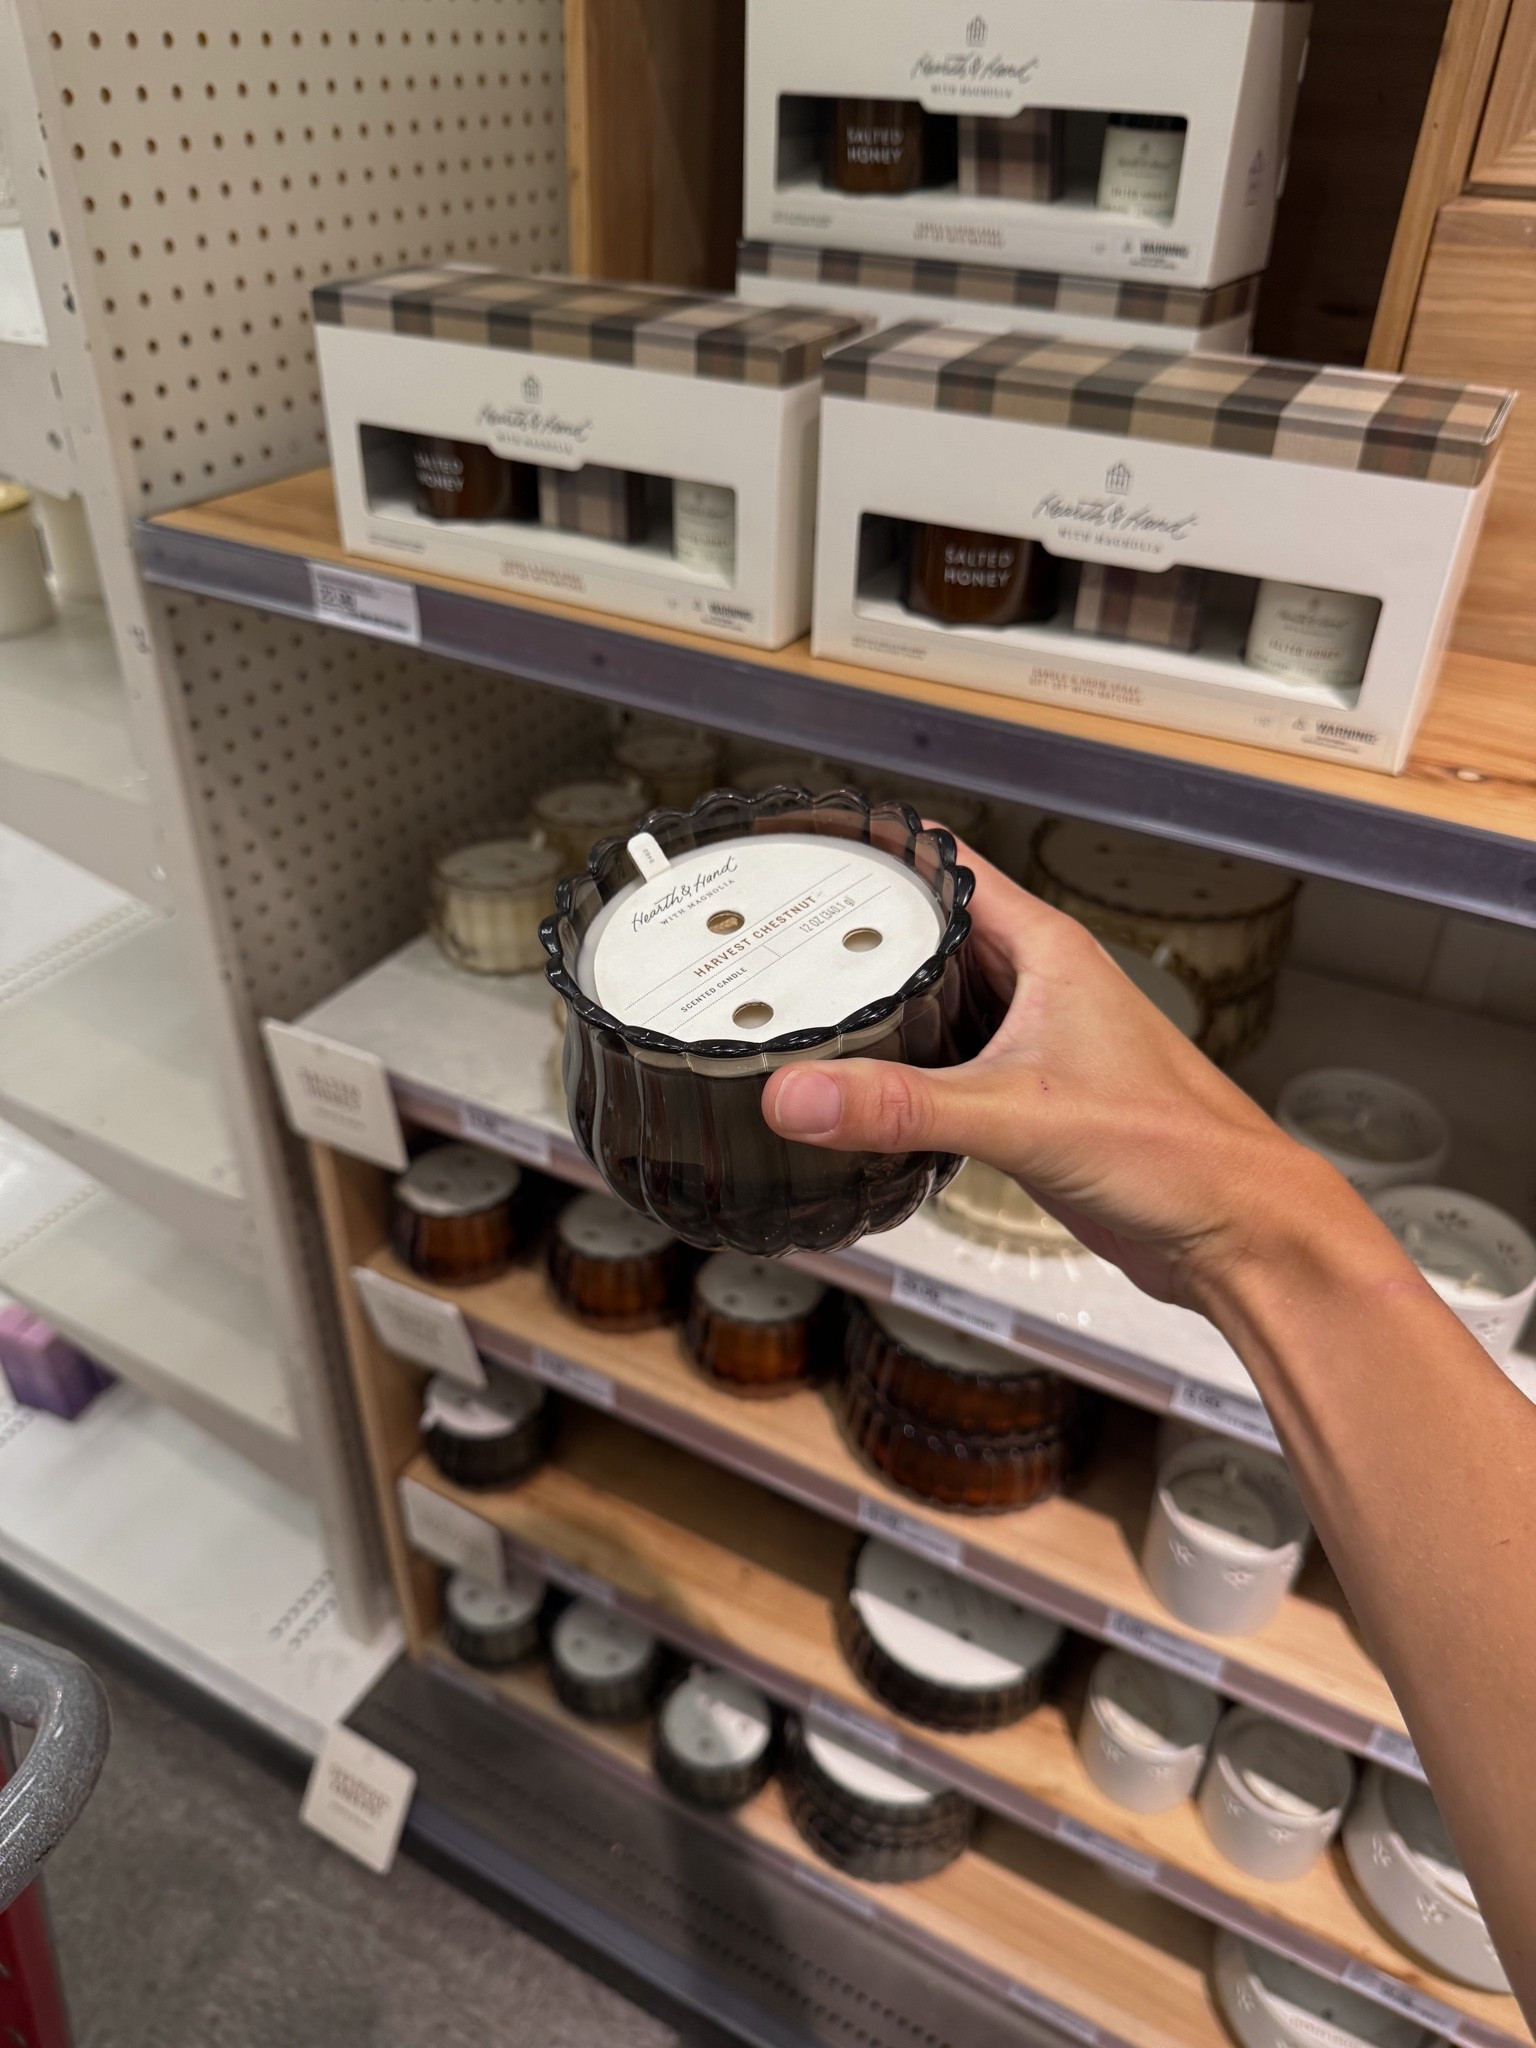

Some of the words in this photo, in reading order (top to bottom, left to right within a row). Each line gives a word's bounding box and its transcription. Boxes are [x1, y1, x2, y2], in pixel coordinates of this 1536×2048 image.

[846, 126, 904, 146] SALTED
[847, 145, 903, 165] HONEY
[413, 450, 464, 476] SALTED
[415, 469, 465, 493] HONEY
[1032, 491, 1117, 526] Hearth
[1120, 503, 1199, 541] Hand
[1057, 526, 1089, 542] WITH
[1094, 532, 1163, 554] MAGNOLIA
[944, 543, 1015, 569] SALTED
[943, 566, 1013, 589] HONEY
[631, 886, 684, 932] Hearth
[681, 884, 692, 898] &
[693, 855, 738, 893] Hand
[660, 909, 686, 925] WITH
[687, 879, 735, 910] MAGNOLIA
[799, 923, 809, 935] 12
[809, 913, 825, 930] OZ
[822, 900, 846, 923] (340.1
[845, 895, 857, 909] g)
[694, 937, 752, 978] HARVEST
[752, 895, 817, 940] CHESTNUT
[680, 987, 717, 1013] SCENTED
[716, 966, 748, 989] CANDLE
